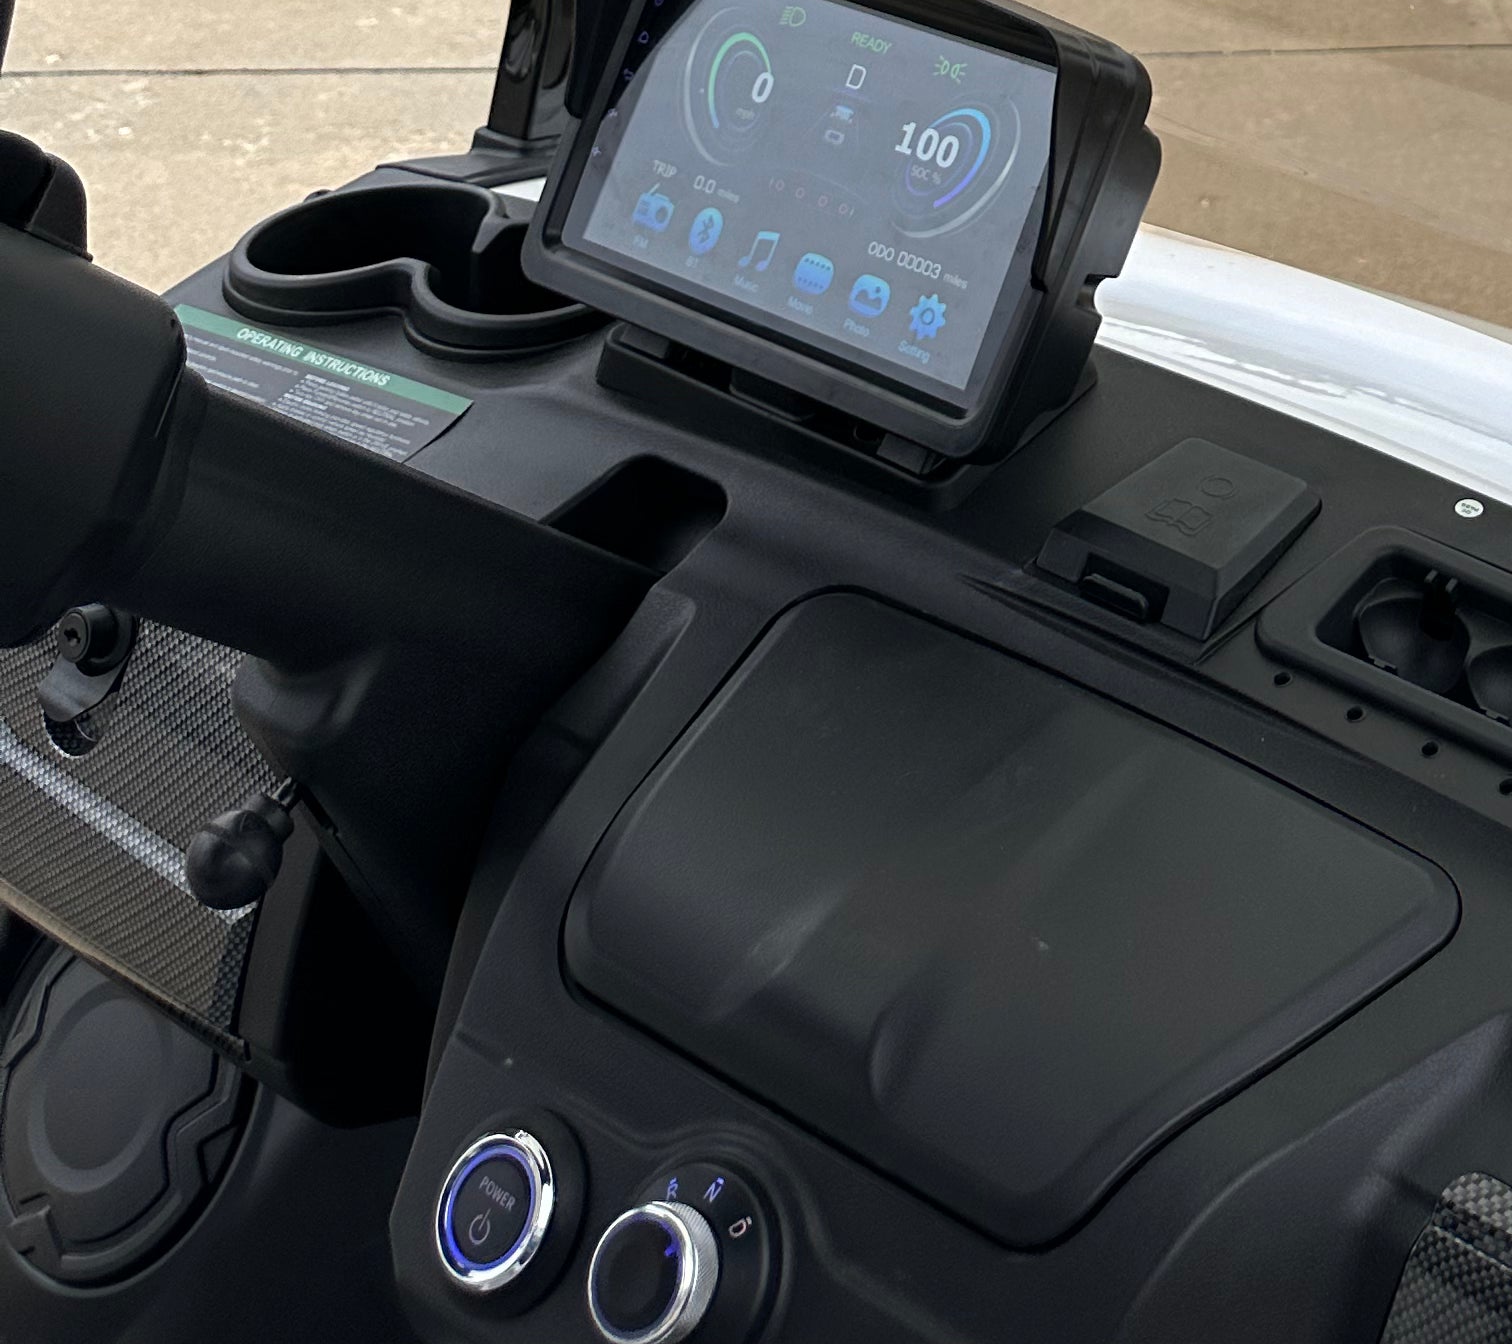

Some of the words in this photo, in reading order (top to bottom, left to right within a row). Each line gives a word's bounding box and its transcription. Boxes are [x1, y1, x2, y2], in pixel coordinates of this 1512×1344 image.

[851, 32, 892, 55] READY
[752, 72, 774, 103] 0
[846, 64, 866, 90] D
[895, 122, 959, 168] 100
[653, 160, 677, 178] TRIP
[694, 175, 716, 194] 0.0
[911, 165, 929, 180] SOC
[867, 241, 895, 261] ODO
[896, 251, 942, 280] 00003
[943, 271, 968, 289] miles
[843, 318, 870, 337] Photo
[236, 328, 304, 357] OPERATING
[303, 351, 391, 386] INSTRUCTIONS
[898, 340, 930, 364] Setting
[479, 1175, 516, 1211] POWER
[666, 1183, 678, 1201] R
[703, 1181, 722, 1203] N
[728, 1218, 747, 1238] D
